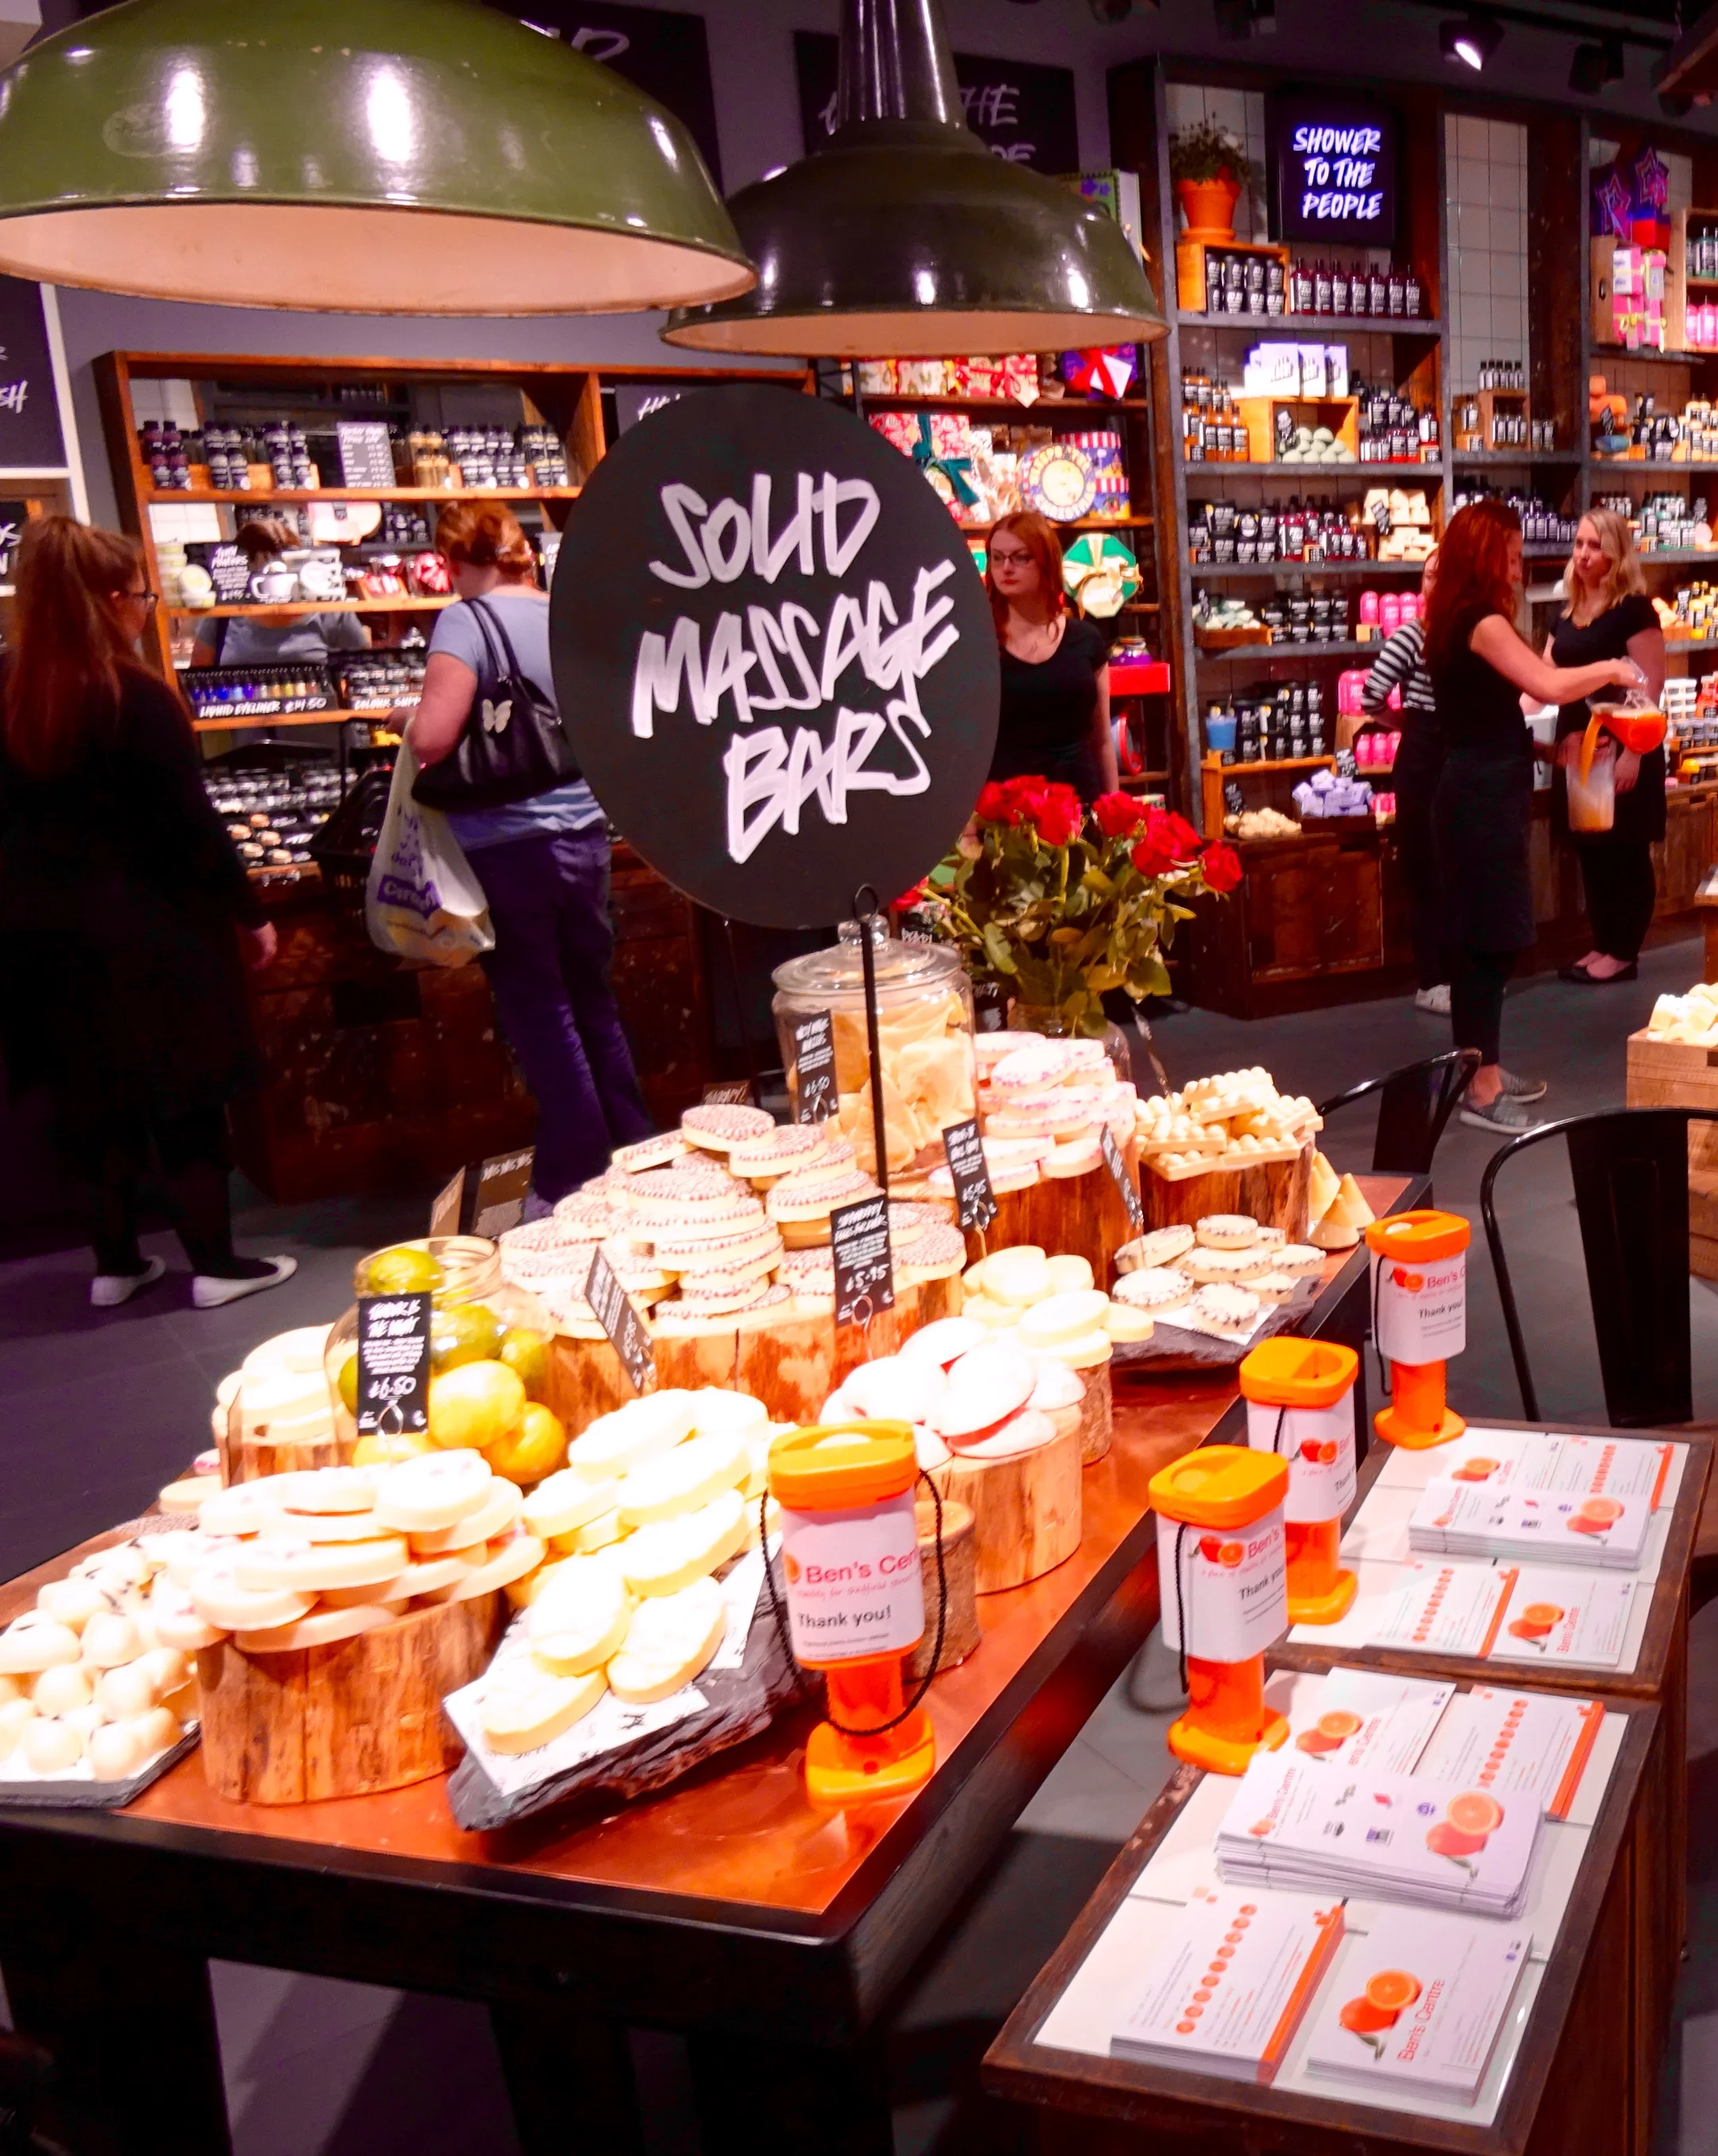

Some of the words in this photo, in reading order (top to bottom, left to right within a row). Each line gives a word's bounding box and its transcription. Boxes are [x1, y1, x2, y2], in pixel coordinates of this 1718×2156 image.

[1292, 126, 1381, 156] SHOWER
[1304, 156, 1330, 186] TO
[1333, 158, 1375, 188] THE
[1302, 191, 1383, 220] PEOPLE
[649, 471, 880, 588] SOLID
[632, 559, 960, 739] MASSAGE
[199, 704, 234, 718] LIQUID
[234, 700, 281, 715] EYELINER
[723, 699, 932, 864] BARS
[1427, 1271, 1458, 1290] Ben's
[1418, 1303, 1446, 1319] Thank
[1247, 1527, 1281, 1559] Ben's
[805, 1560, 872, 1584] Ben's
[1239, 1573, 1270, 1600] Thank
[797, 1612, 849, 1628] Thank
[852, 1604, 892, 1627] you!
[1414, 1978, 1446, 2023] Centre
